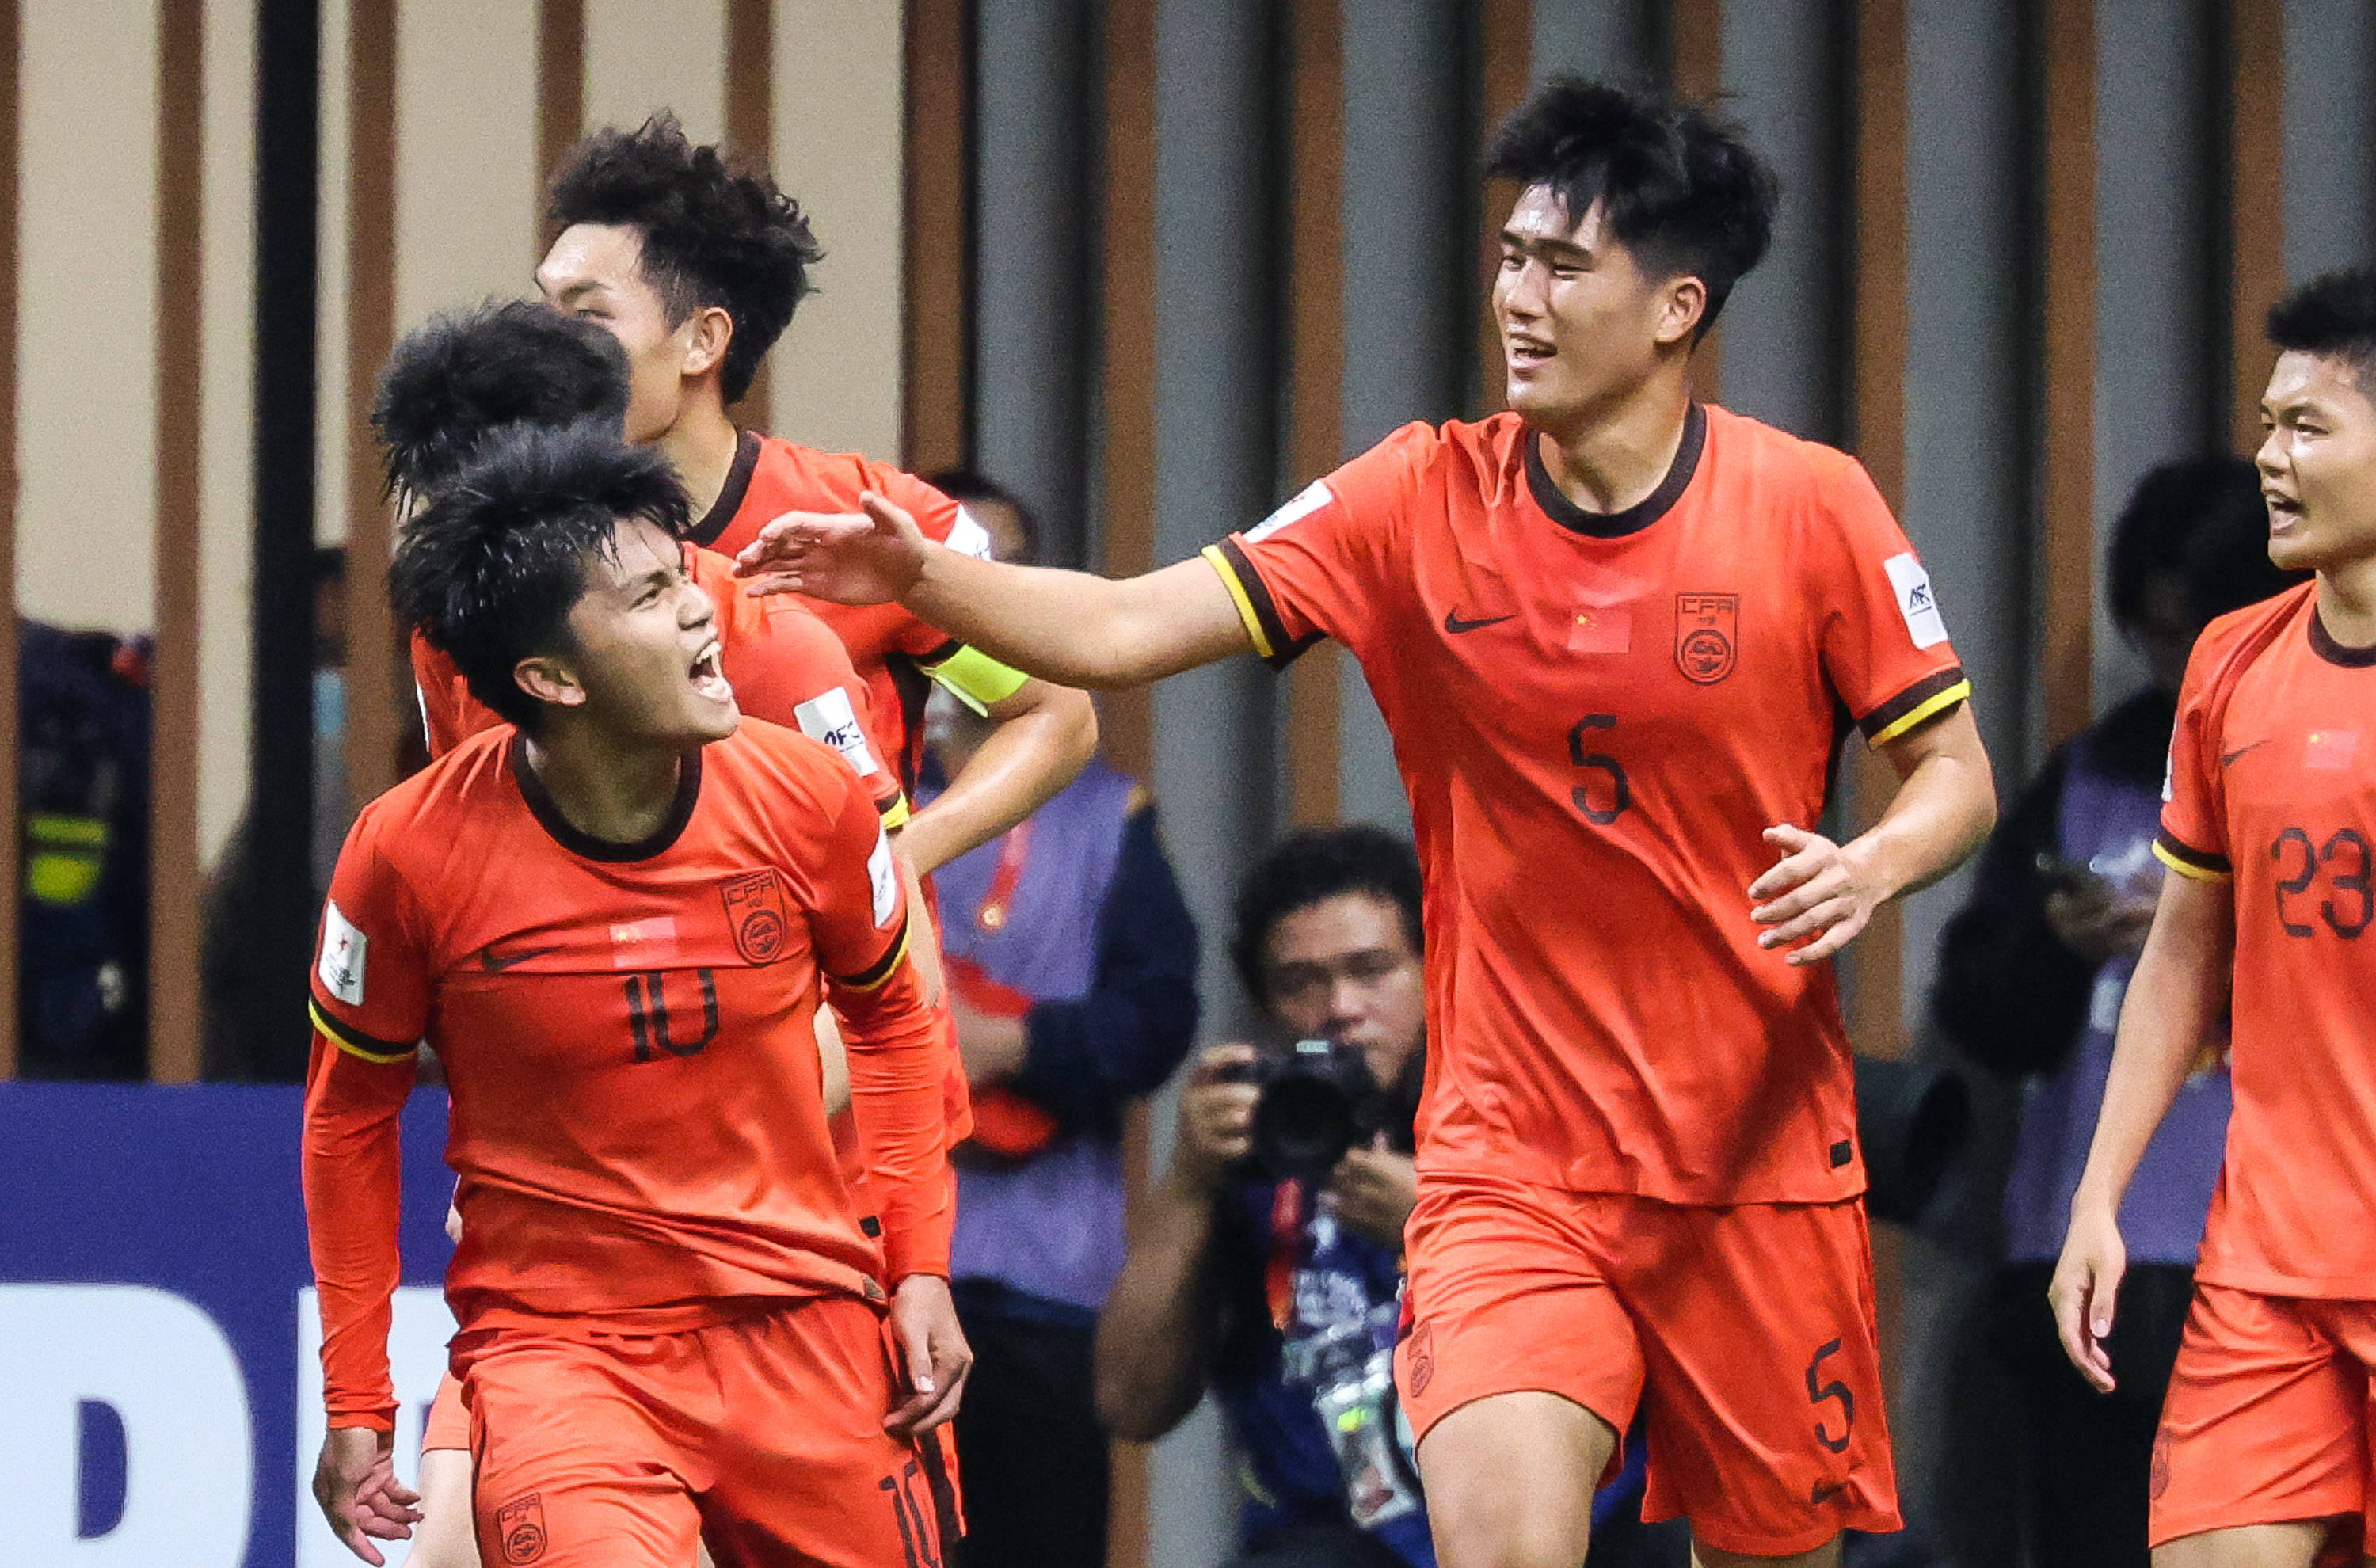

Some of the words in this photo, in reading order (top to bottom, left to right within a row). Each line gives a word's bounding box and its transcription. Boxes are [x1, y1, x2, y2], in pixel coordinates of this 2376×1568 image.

[1567, 714, 1632, 824] 5
[2271, 827, 2375, 940] 23
[624, 968, 718, 1063] 10
[1804, 1338, 1855, 1454] 5
